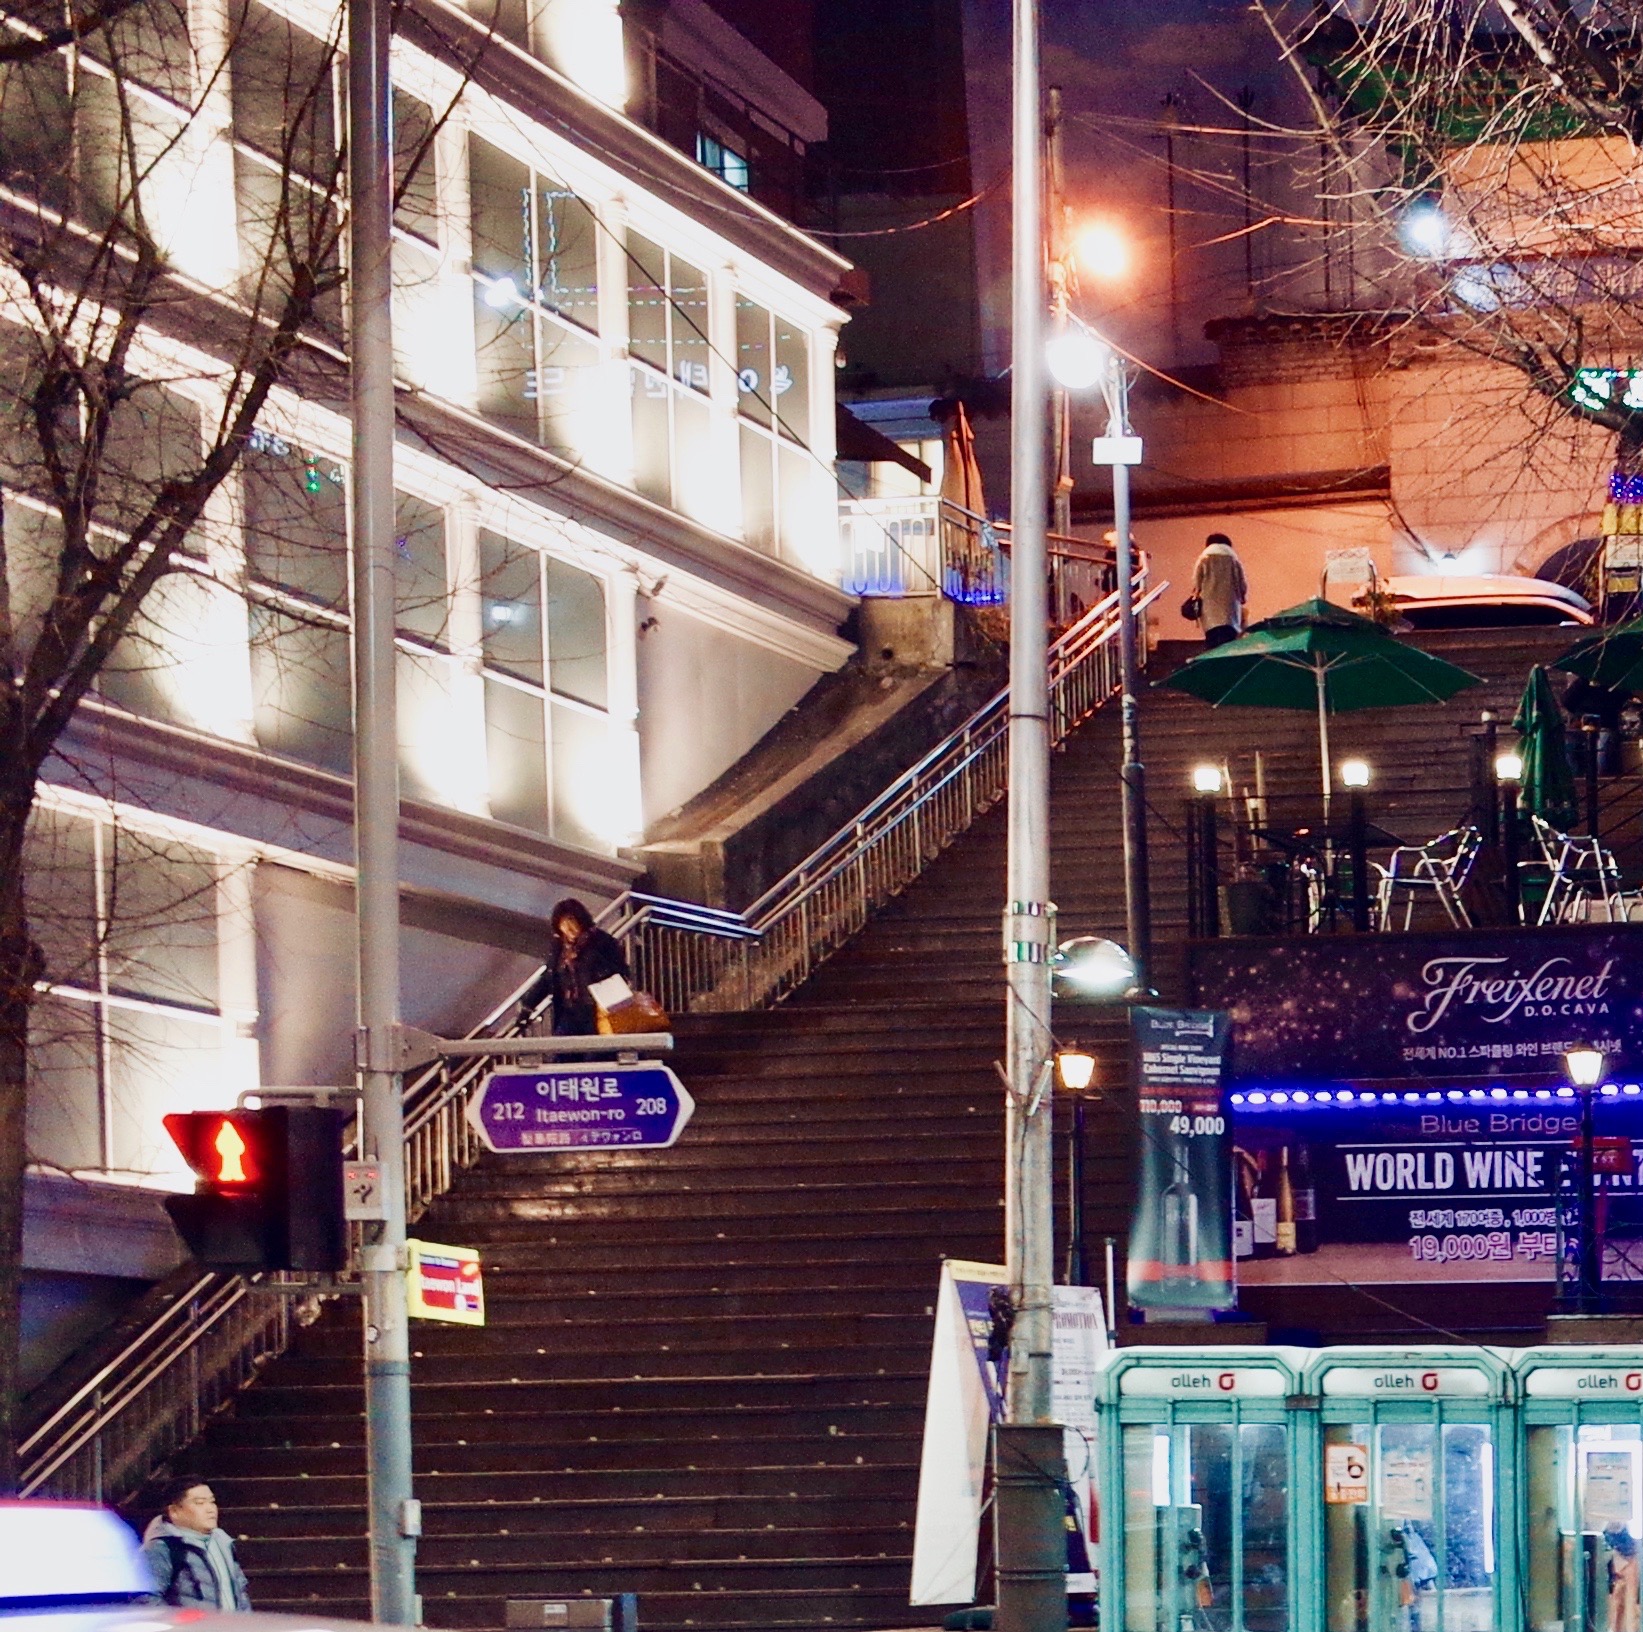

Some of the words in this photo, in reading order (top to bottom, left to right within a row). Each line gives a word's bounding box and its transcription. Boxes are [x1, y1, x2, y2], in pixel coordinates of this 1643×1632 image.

[1406, 956, 1614, 1033] Freixenet
[1524, 1004, 1557, 1017] D.O.
[1561, 1002, 1610, 1015] CAVA
[535, 1076, 623, 1103] 이태원로
[492, 1102, 525, 1121] 212
[535, 1108, 626, 1123] Itaewon-ro
[635, 1097, 667, 1116] 208
[1169, 1115, 1225, 1138] 49,000
[1420, 1114, 1480, 1134] Blue
[1489, 1112, 1578, 1133] Bridge
[1345, 1152, 1454, 1191] WORLD
[1463, 1150, 1545, 1189] WINE
[1409, 1231, 1513, 1262] 19,000원
[1170, 1374, 1212, 1389] olleh
[1374, 1374, 1415, 1389] olleh
[1577, 1374, 1619, 1389] olleh
